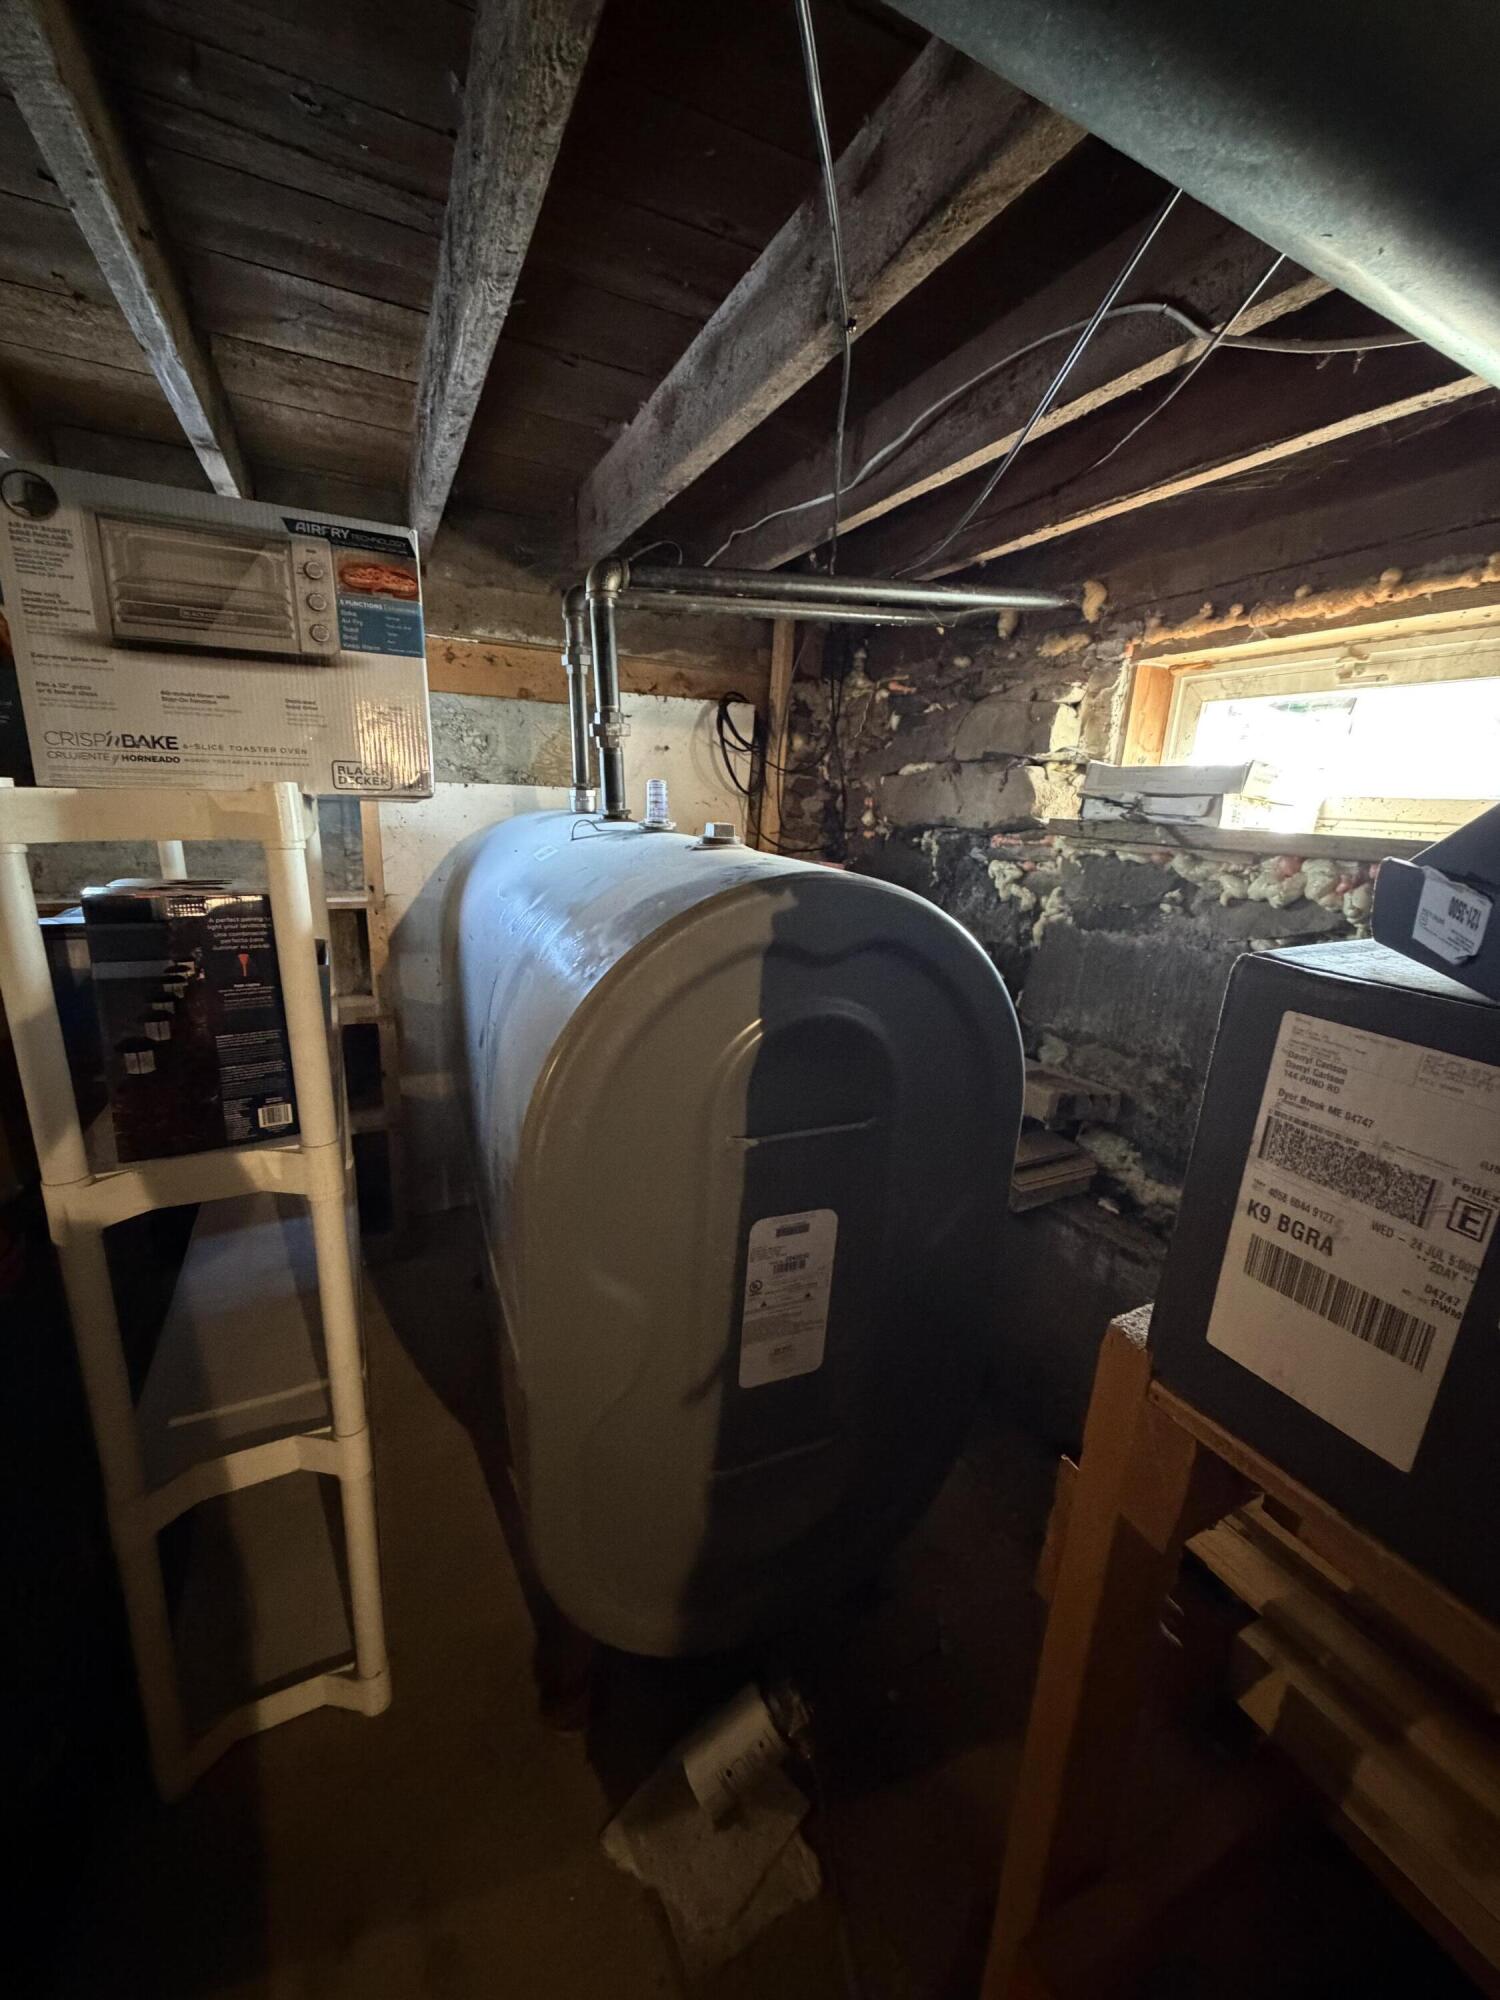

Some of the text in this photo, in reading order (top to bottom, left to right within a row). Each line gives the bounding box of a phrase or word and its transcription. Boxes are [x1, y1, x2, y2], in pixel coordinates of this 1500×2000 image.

[295, 521, 350, 539] AIRFRY
[46, 750, 110, 761] CRUJIENTE
[121, 754, 181, 764] HORNEADO
[229, 744, 277, 754] TOASTER
[279, 747, 308, 755] OVEN
[338, 776, 389, 786] DECKER
[1247, 1198, 1333, 1257] K9 BGRA
[1458, 1205, 1484, 1236] E
[1371, 1220, 1394, 1239] WED
[1410, 1238, 1423, 1251] 24
[1425, 1244, 1445, 1262] JUL
[1428, 1260, 1459, 1281] 2DAY
